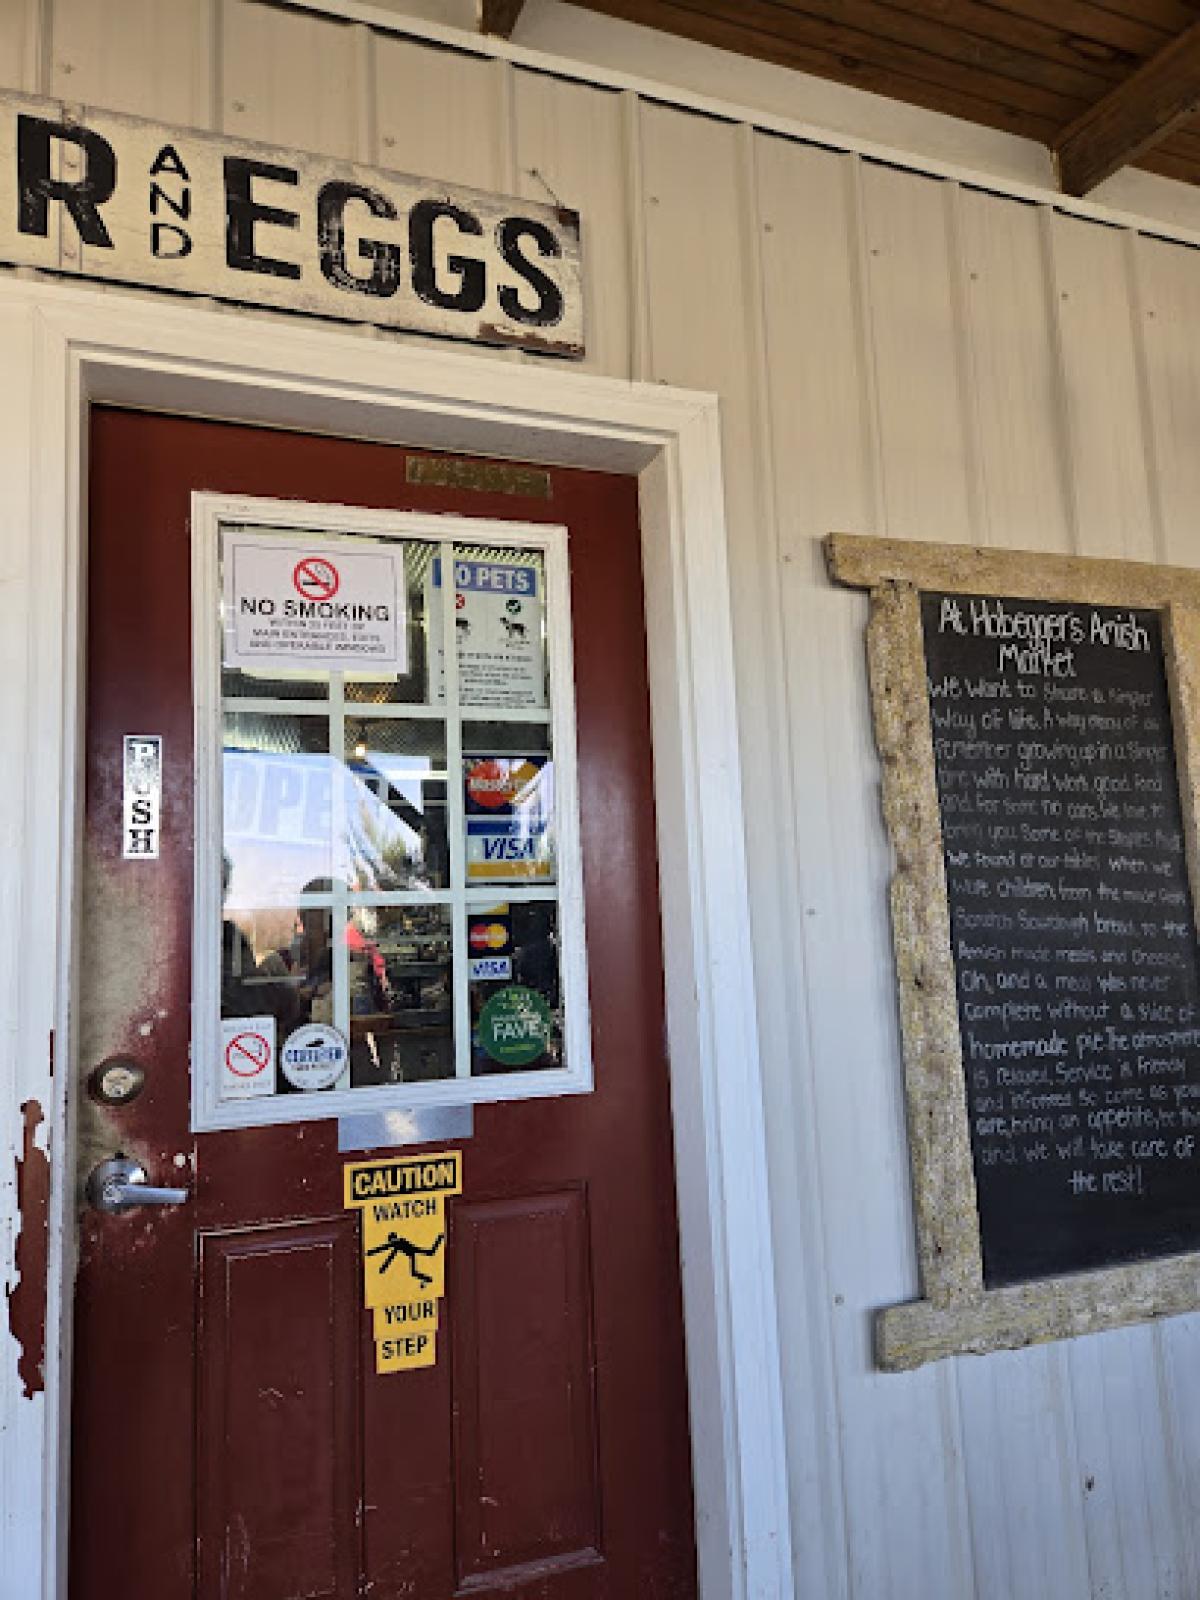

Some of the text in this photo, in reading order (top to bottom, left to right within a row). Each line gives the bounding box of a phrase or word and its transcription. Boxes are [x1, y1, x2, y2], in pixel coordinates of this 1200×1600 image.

[17, 114, 564, 328] R AND EGGS
[456, 563, 528, 592] O PETS
[240, 597, 389, 622] NO SMOKING
[1090, 611, 1151, 653] Amish
[997, 640, 1078, 677] Market
[1016, 678, 1036, 698] to
[981, 708, 1004, 730] of
[127, 742, 157, 855] PUSH
[482, 836, 537, 861] VISA
[471, 960, 509, 978] VISA
[967, 1028, 1070, 1060] homemade
[1149, 1084, 1168, 1100] as
[1131, 1139, 1168, 1159] care
[1173, 1135, 1195, 1159] of
[353, 1161, 455, 1197] CAUTION
[1067, 1170, 1098, 1195] the
[372, 1197, 437, 1223] WATCH
[383, 1300, 435, 1325] YOUR
[381, 1334, 429, 1360] STEP
